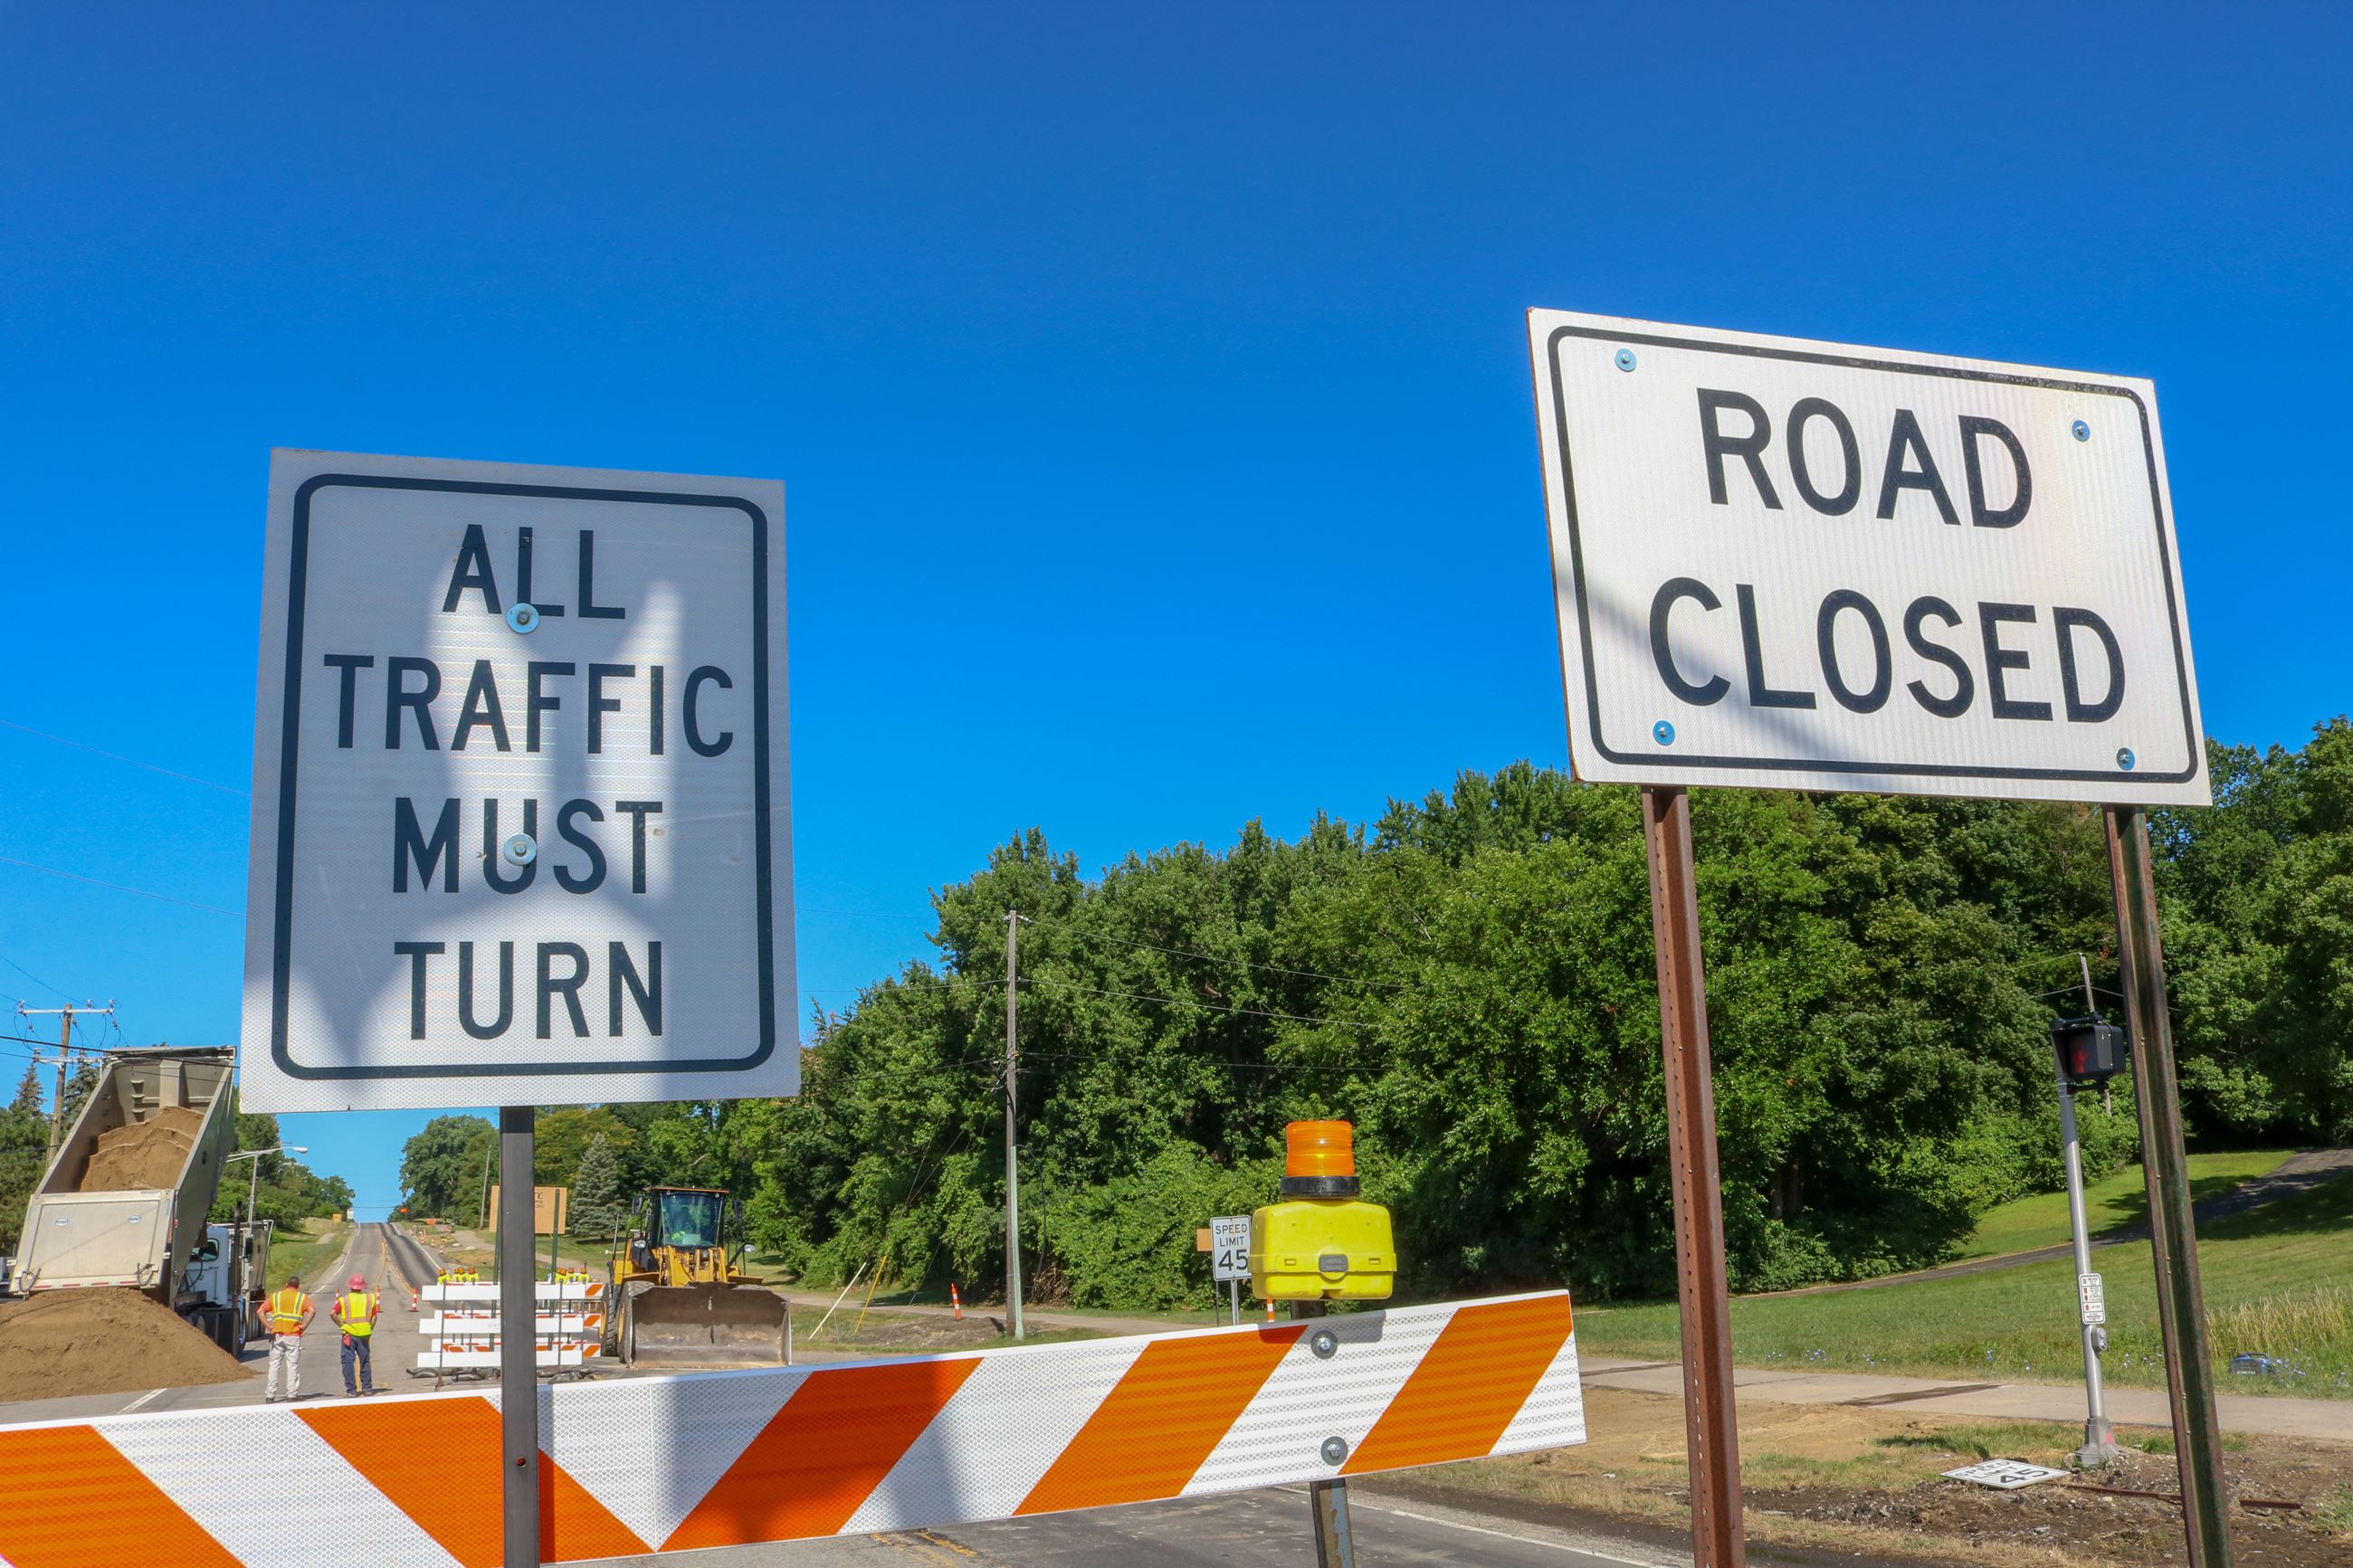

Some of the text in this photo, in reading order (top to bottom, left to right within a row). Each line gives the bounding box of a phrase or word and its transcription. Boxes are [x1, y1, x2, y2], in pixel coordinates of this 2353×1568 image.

[1697, 388, 2032, 528] ROAD
[442, 522, 626, 621] ALL
[1649, 577, 2125, 724] CLOSED
[322, 653, 734, 757] TRAFFIC
[393, 797, 662, 896] MUST
[393, 941, 663, 1040] TURN
[1215, 1223, 1247, 1234] SPEED
[1219, 1236, 1244, 1247] LIMIT
[1218, 1249, 1248, 1271] 45
[1955, 1460, 2011, 1478] SPEED
[1974, 1465, 2018, 1479] LIMIT
[2000, 1468, 2050, 1484] 45
